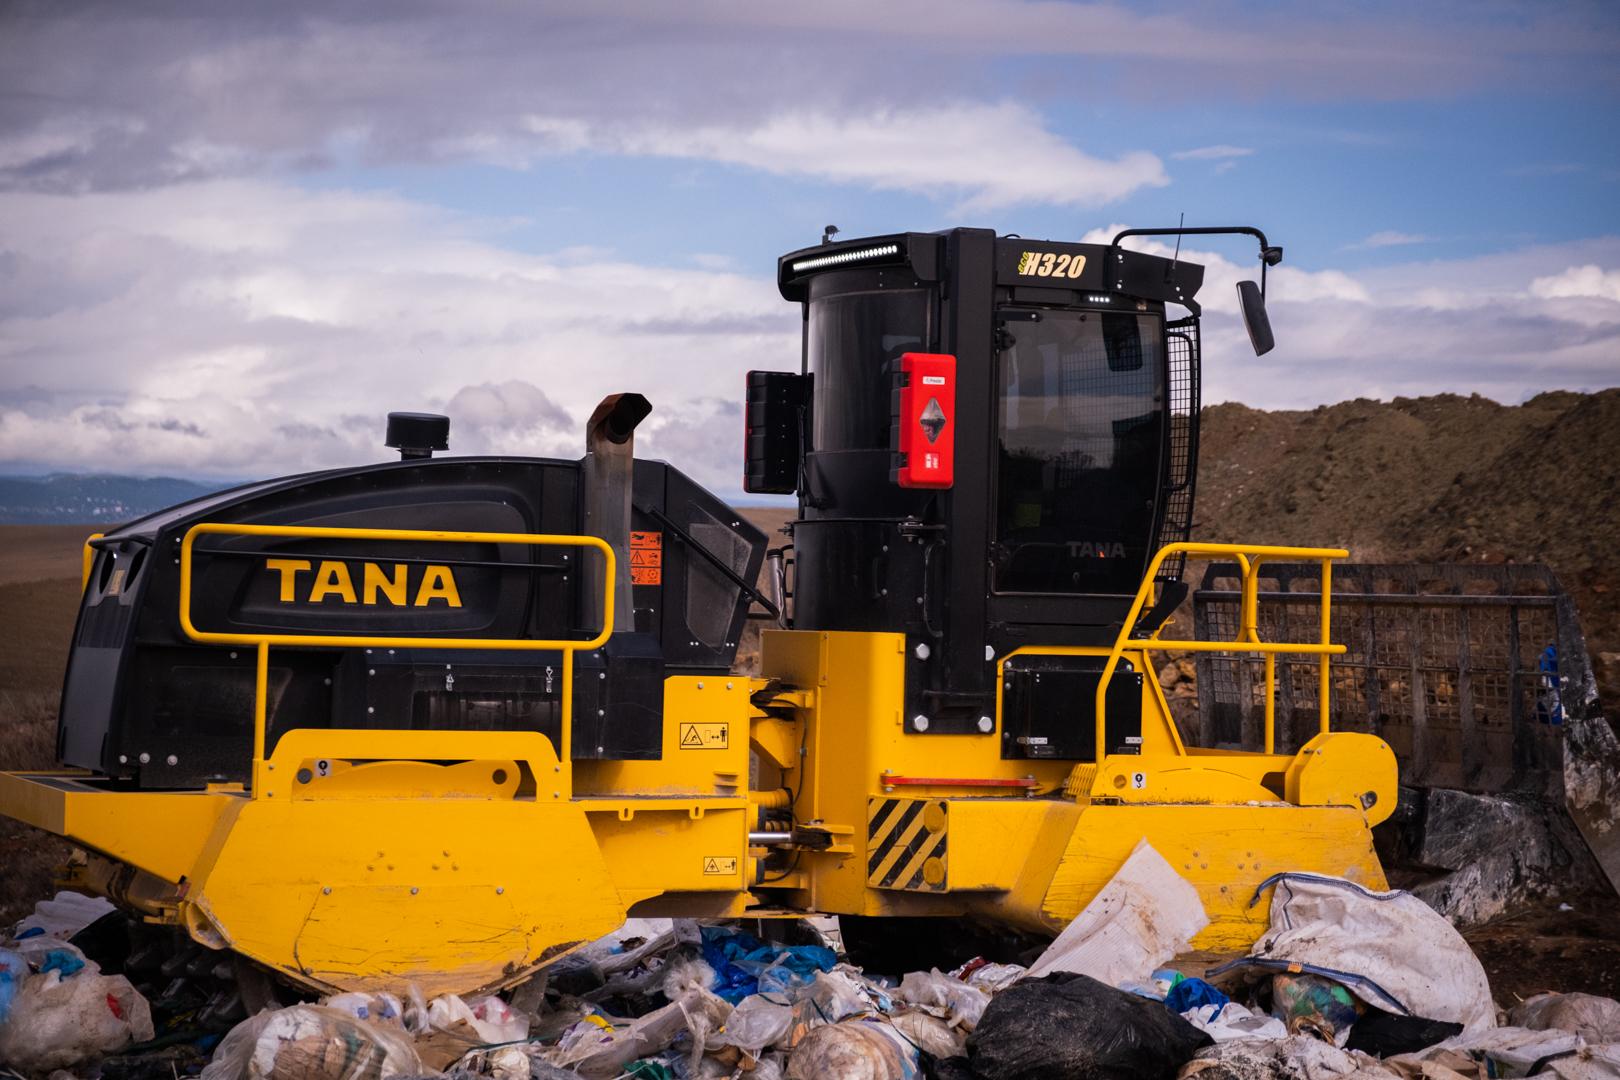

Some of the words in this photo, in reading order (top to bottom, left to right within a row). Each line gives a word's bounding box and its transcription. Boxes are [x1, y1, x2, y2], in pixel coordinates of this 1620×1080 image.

[1019, 252, 1087, 279] H320
[1066, 541, 1126, 558] TANA
[266, 558, 463, 608] TANA
